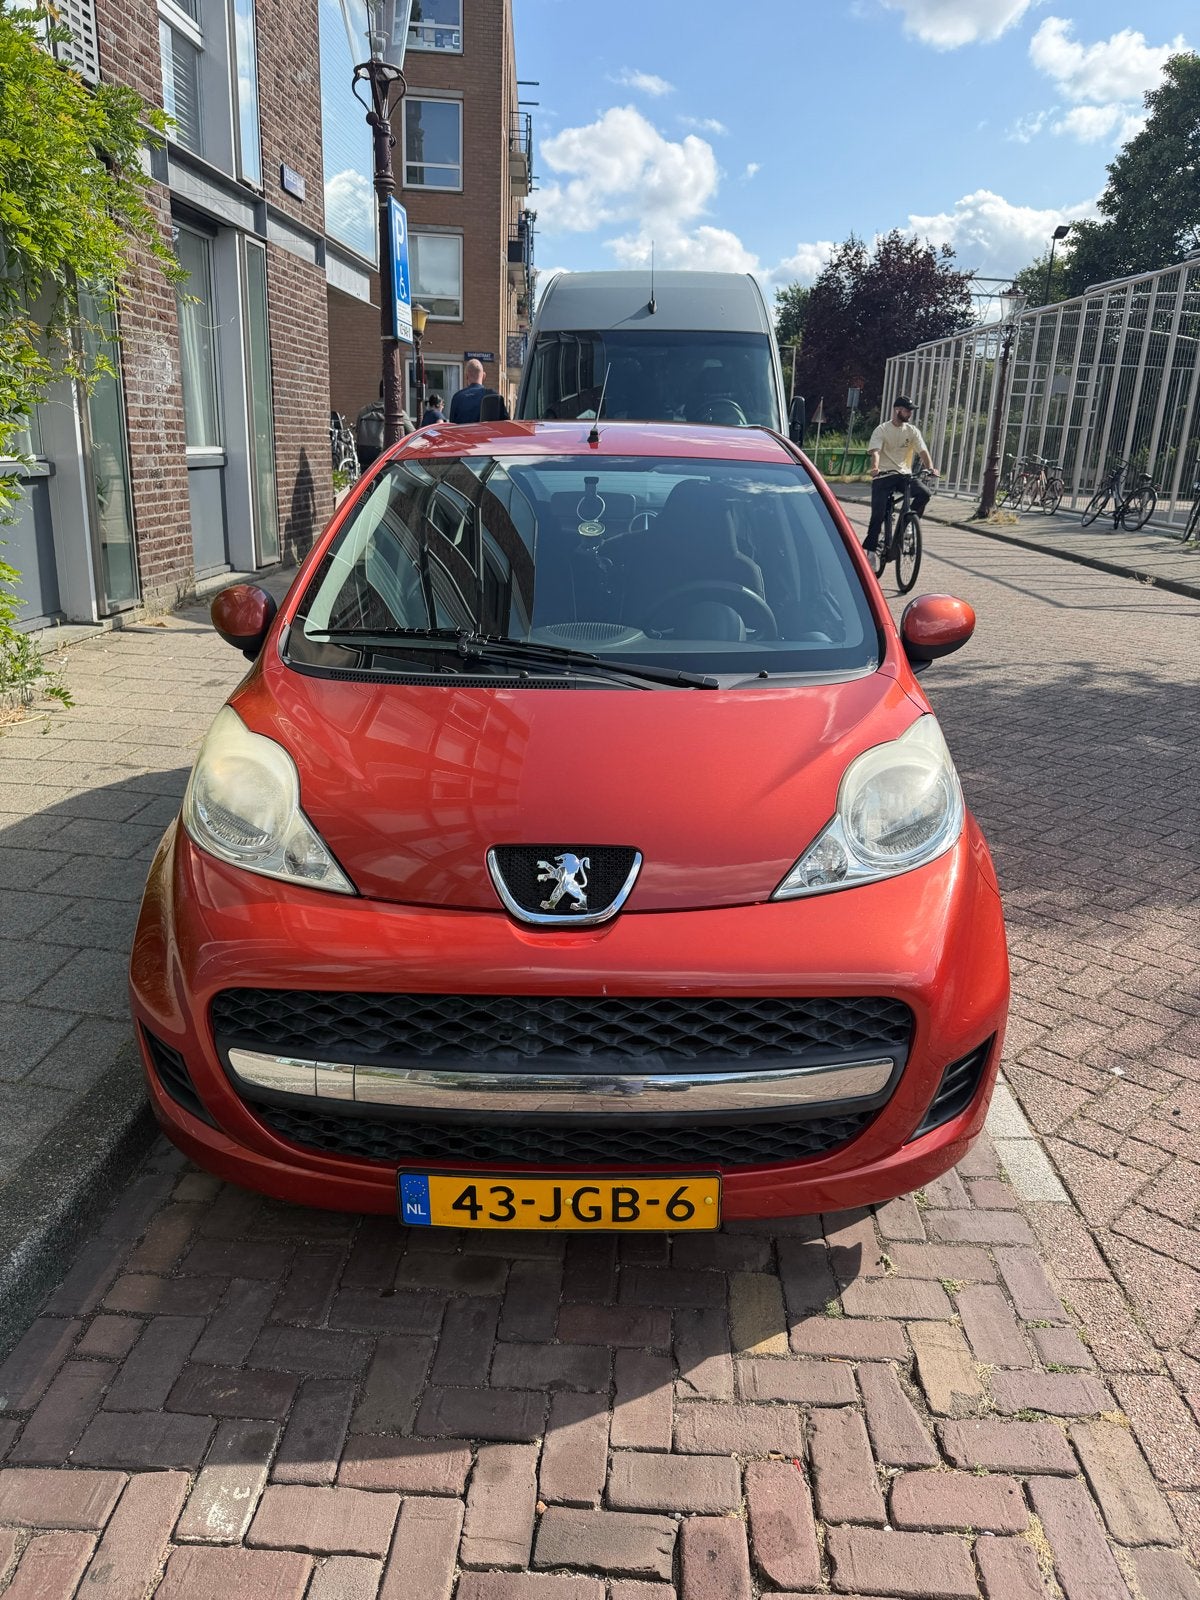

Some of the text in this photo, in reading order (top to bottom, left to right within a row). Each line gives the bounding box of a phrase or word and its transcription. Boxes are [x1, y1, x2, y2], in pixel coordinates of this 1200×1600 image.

[395, 209, 404, 261] P
[406, 1203, 427, 1216] NL
[451, 1185, 695, 1223] 43-JGB-6
